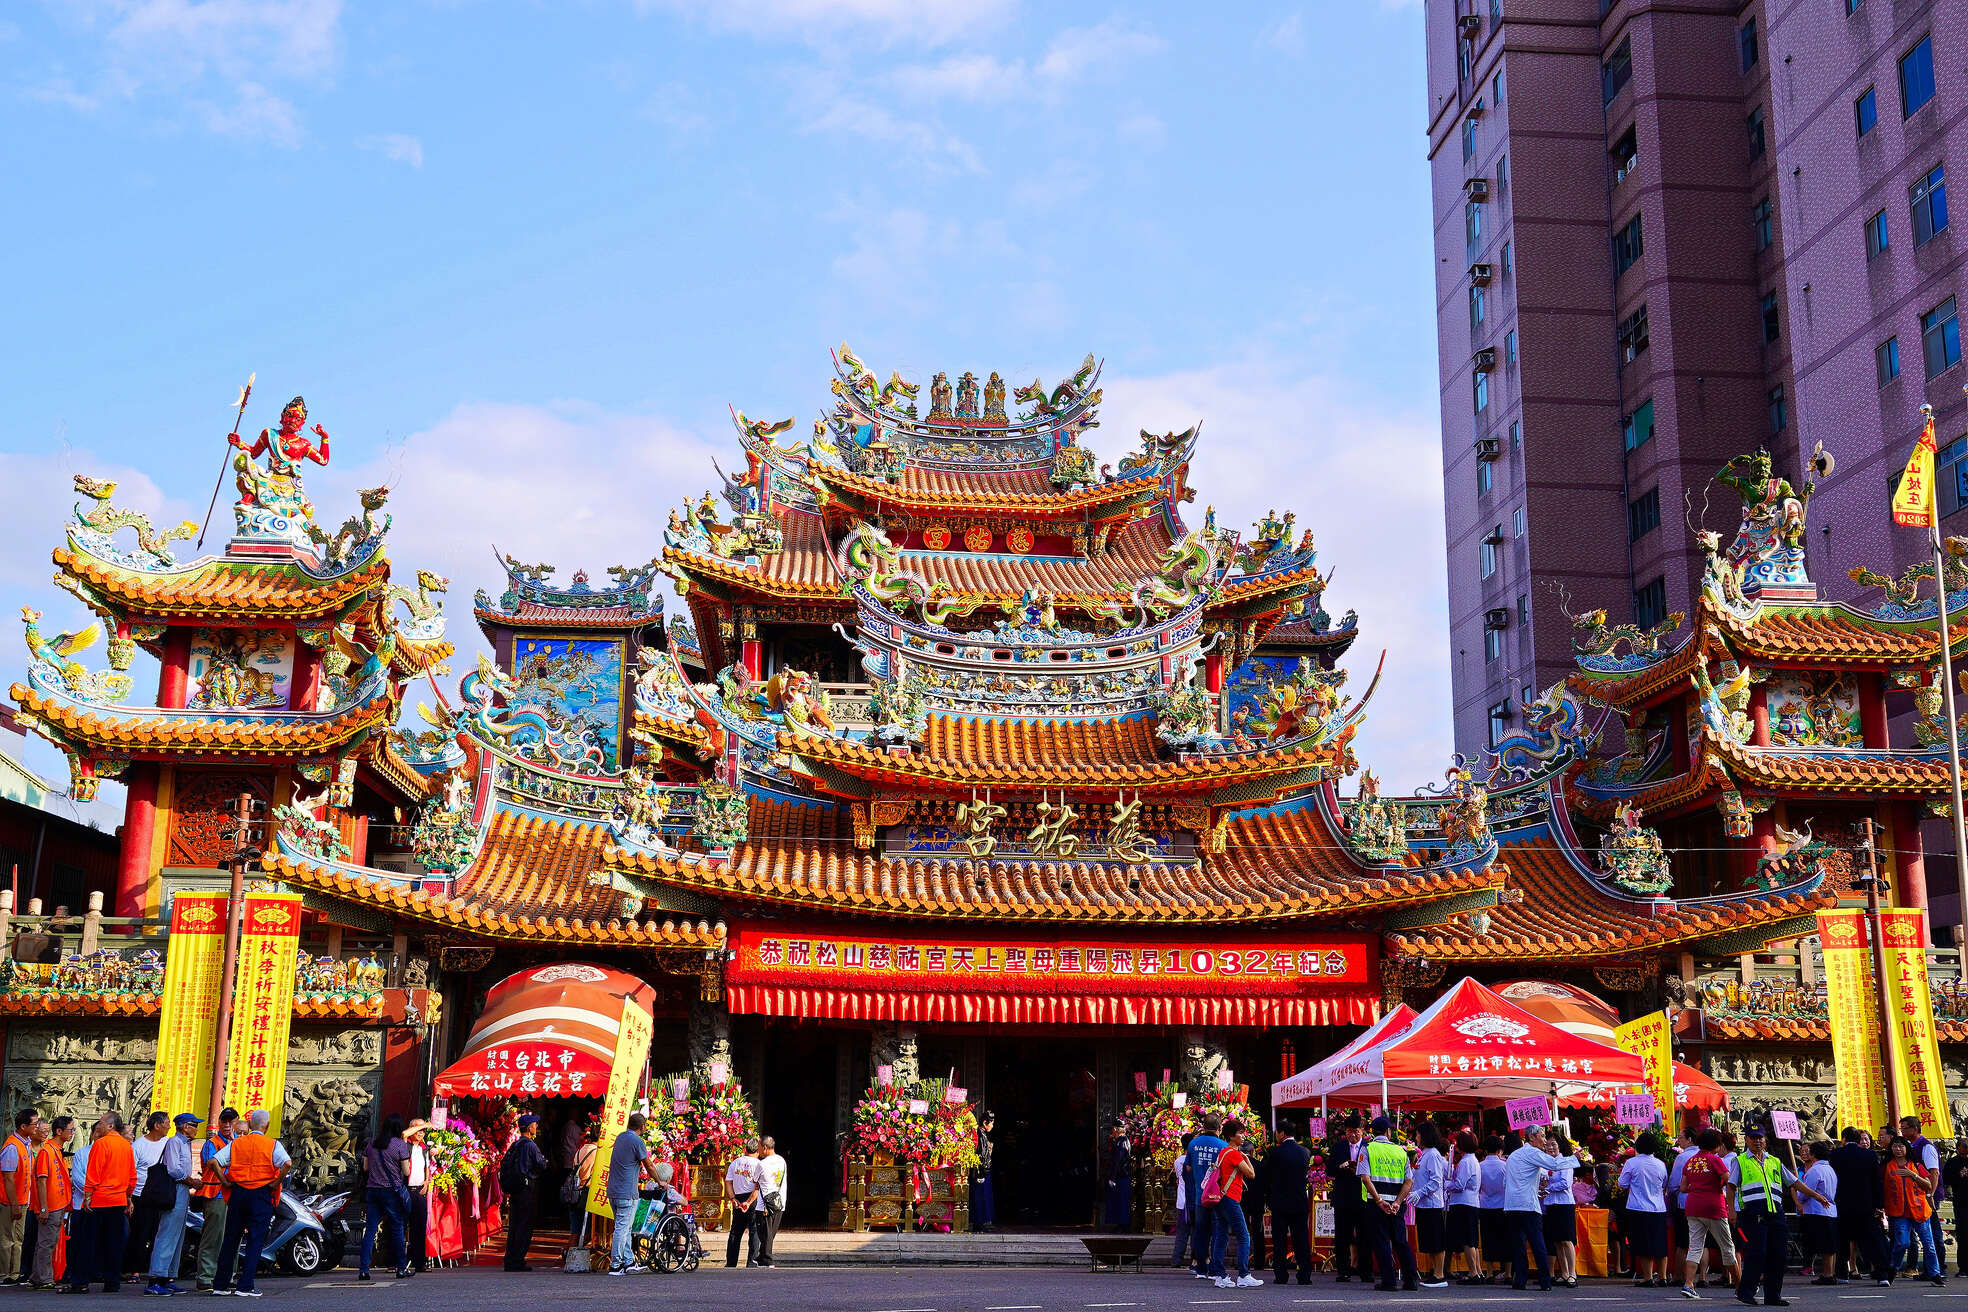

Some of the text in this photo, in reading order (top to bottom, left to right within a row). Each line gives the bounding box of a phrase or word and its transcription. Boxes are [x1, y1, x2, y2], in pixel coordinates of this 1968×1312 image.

[956, 800, 1157, 864] 慈祐宮
[760, 939, 1346, 976] 恭祝松山慈祐宮天上聖母重陽飛昇1032年紀念
[487, 1050, 509, 1059] 財團
[515, 1050, 576, 1070] 台北市
[1429, 1055, 1450, 1064] 財團
[487, 1060, 510, 1069] 法人
[1429, 1065, 1452, 1074] 法人
[1457, 1055, 1594, 1074] 台北市松山慈祐宮
[470, 1071, 586, 1092] 松山慈祐宮
[1673, 1083, 1690, 1103] 宮
